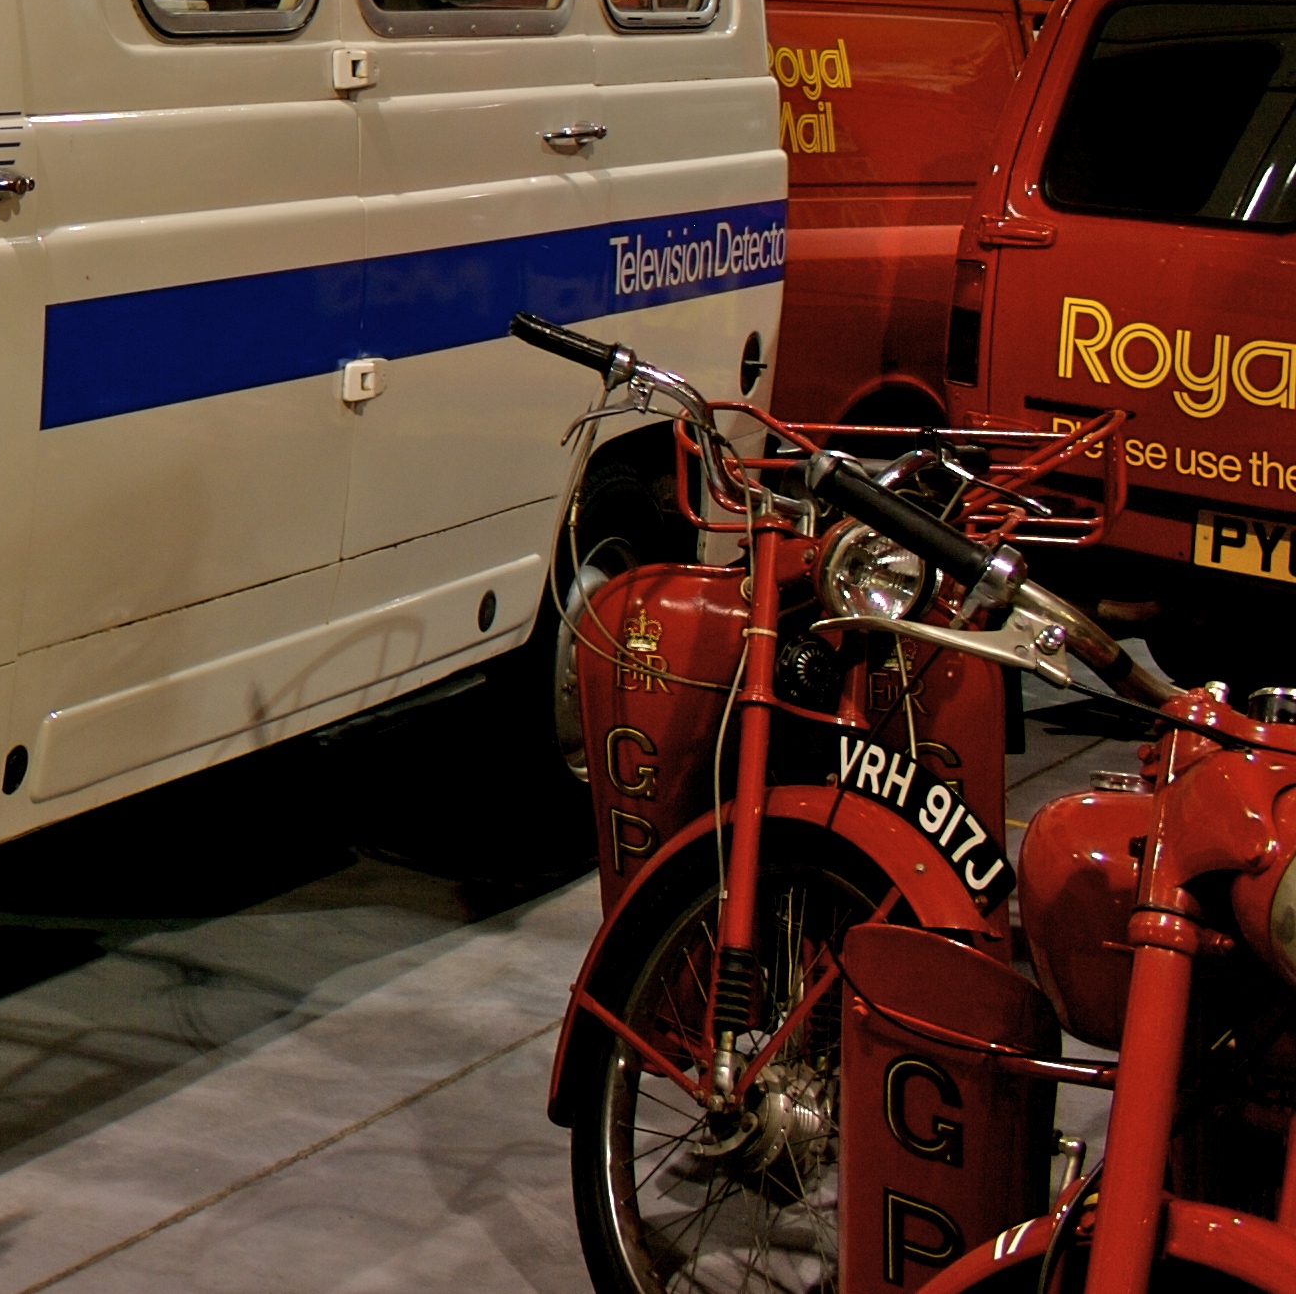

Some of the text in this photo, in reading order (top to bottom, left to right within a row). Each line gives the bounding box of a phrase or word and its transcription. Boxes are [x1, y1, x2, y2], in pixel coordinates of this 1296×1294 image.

[610, 228, 712, 295] Television
[1175, 442, 1242, 483] use
[1210, 514, 1296, 574] PY
[840, 734, 1005, 891] VRH 917J
